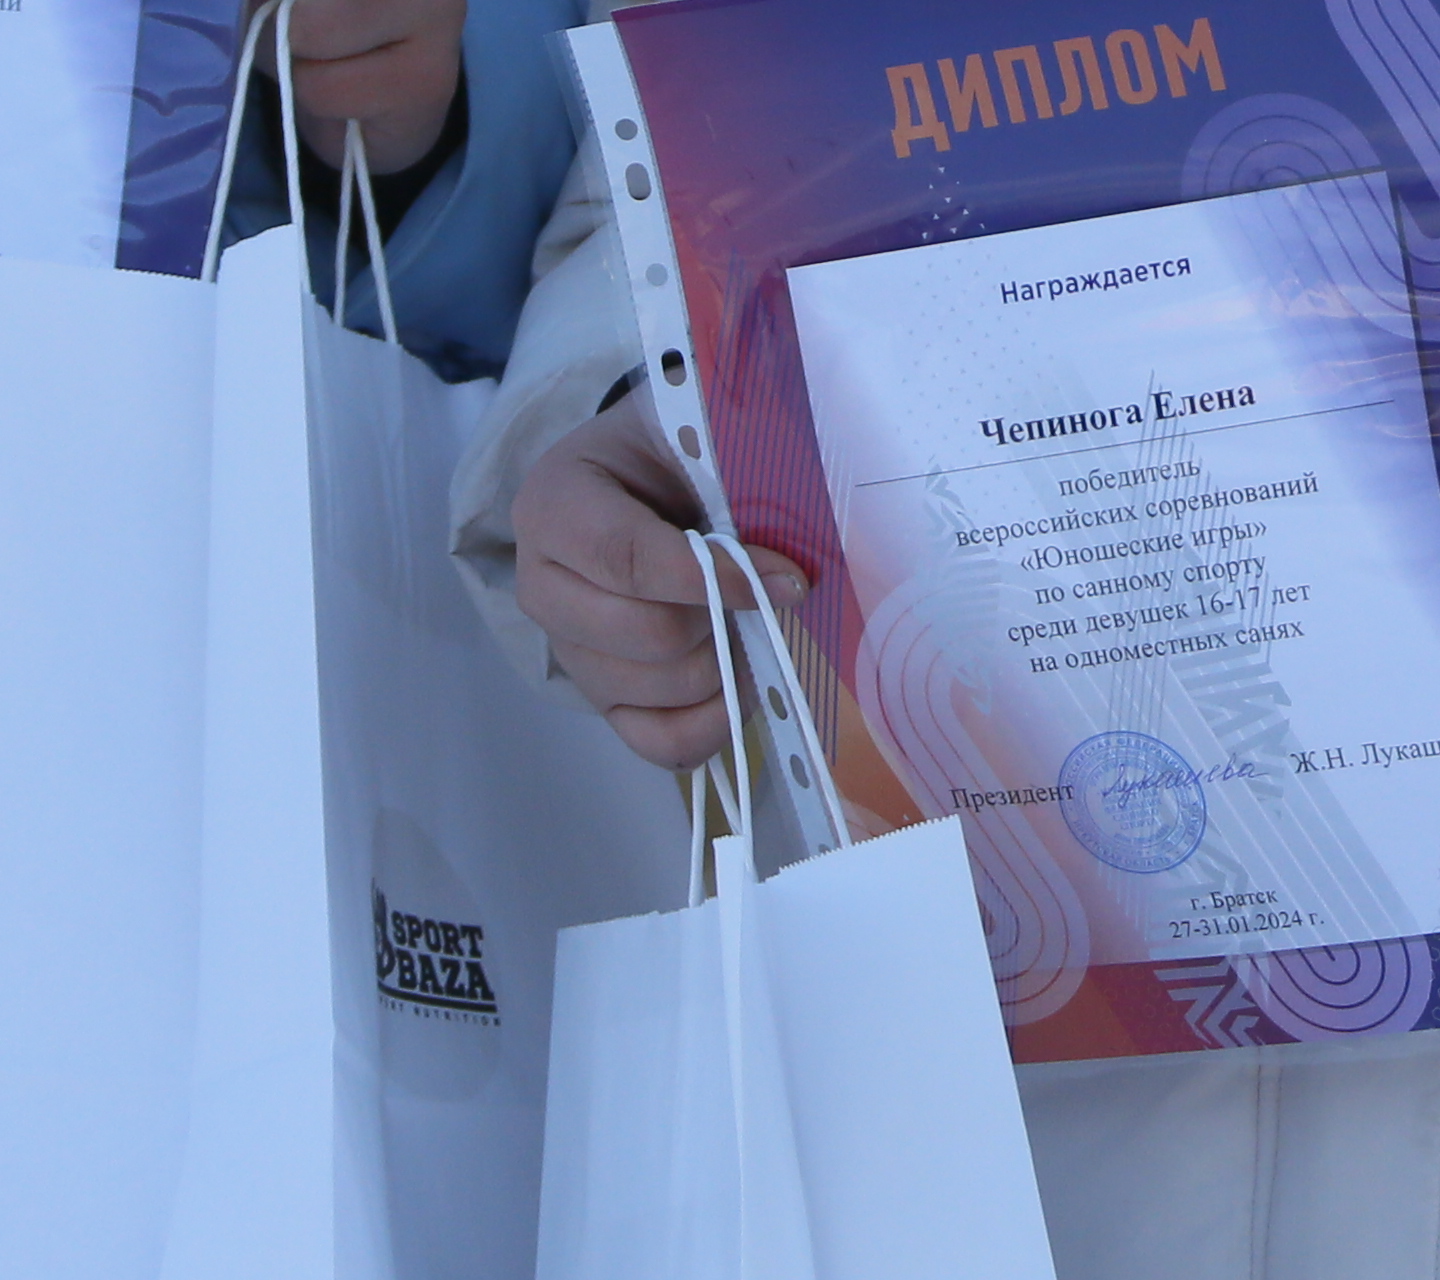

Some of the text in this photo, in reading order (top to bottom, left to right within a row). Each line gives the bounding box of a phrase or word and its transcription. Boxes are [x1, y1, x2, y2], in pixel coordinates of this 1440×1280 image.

[885, 16, 1228, 160] ДИПЛОМ
[1000, 257, 1190, 303] Награждается
[980, 386, 1255, 445] Чепинога Елена
[1058, 460, 1200, 496] победитель
[955, 471, 1317, 547] всероссийских соревнований
[1020, 522, 1266, 570] «Юношеские игры»
[1034, 557, 1266, 604] по санному спорту
[1007, 585, 1309, 646] среди девушек 16-17 лет
[1029, 621, 1303, 672] на одноместных санях
[951, 784, 1074, 817] Президент
[1289, 747, 1353, 773] Ж.Н.
[1169, 909, 1324, 938] 27-31.01.2024 г.
[1190, 890, 1277, 912] г. Братск
[391, 910, 484, 959] SPORT
[395, 947, 496, 1001] BAZA
